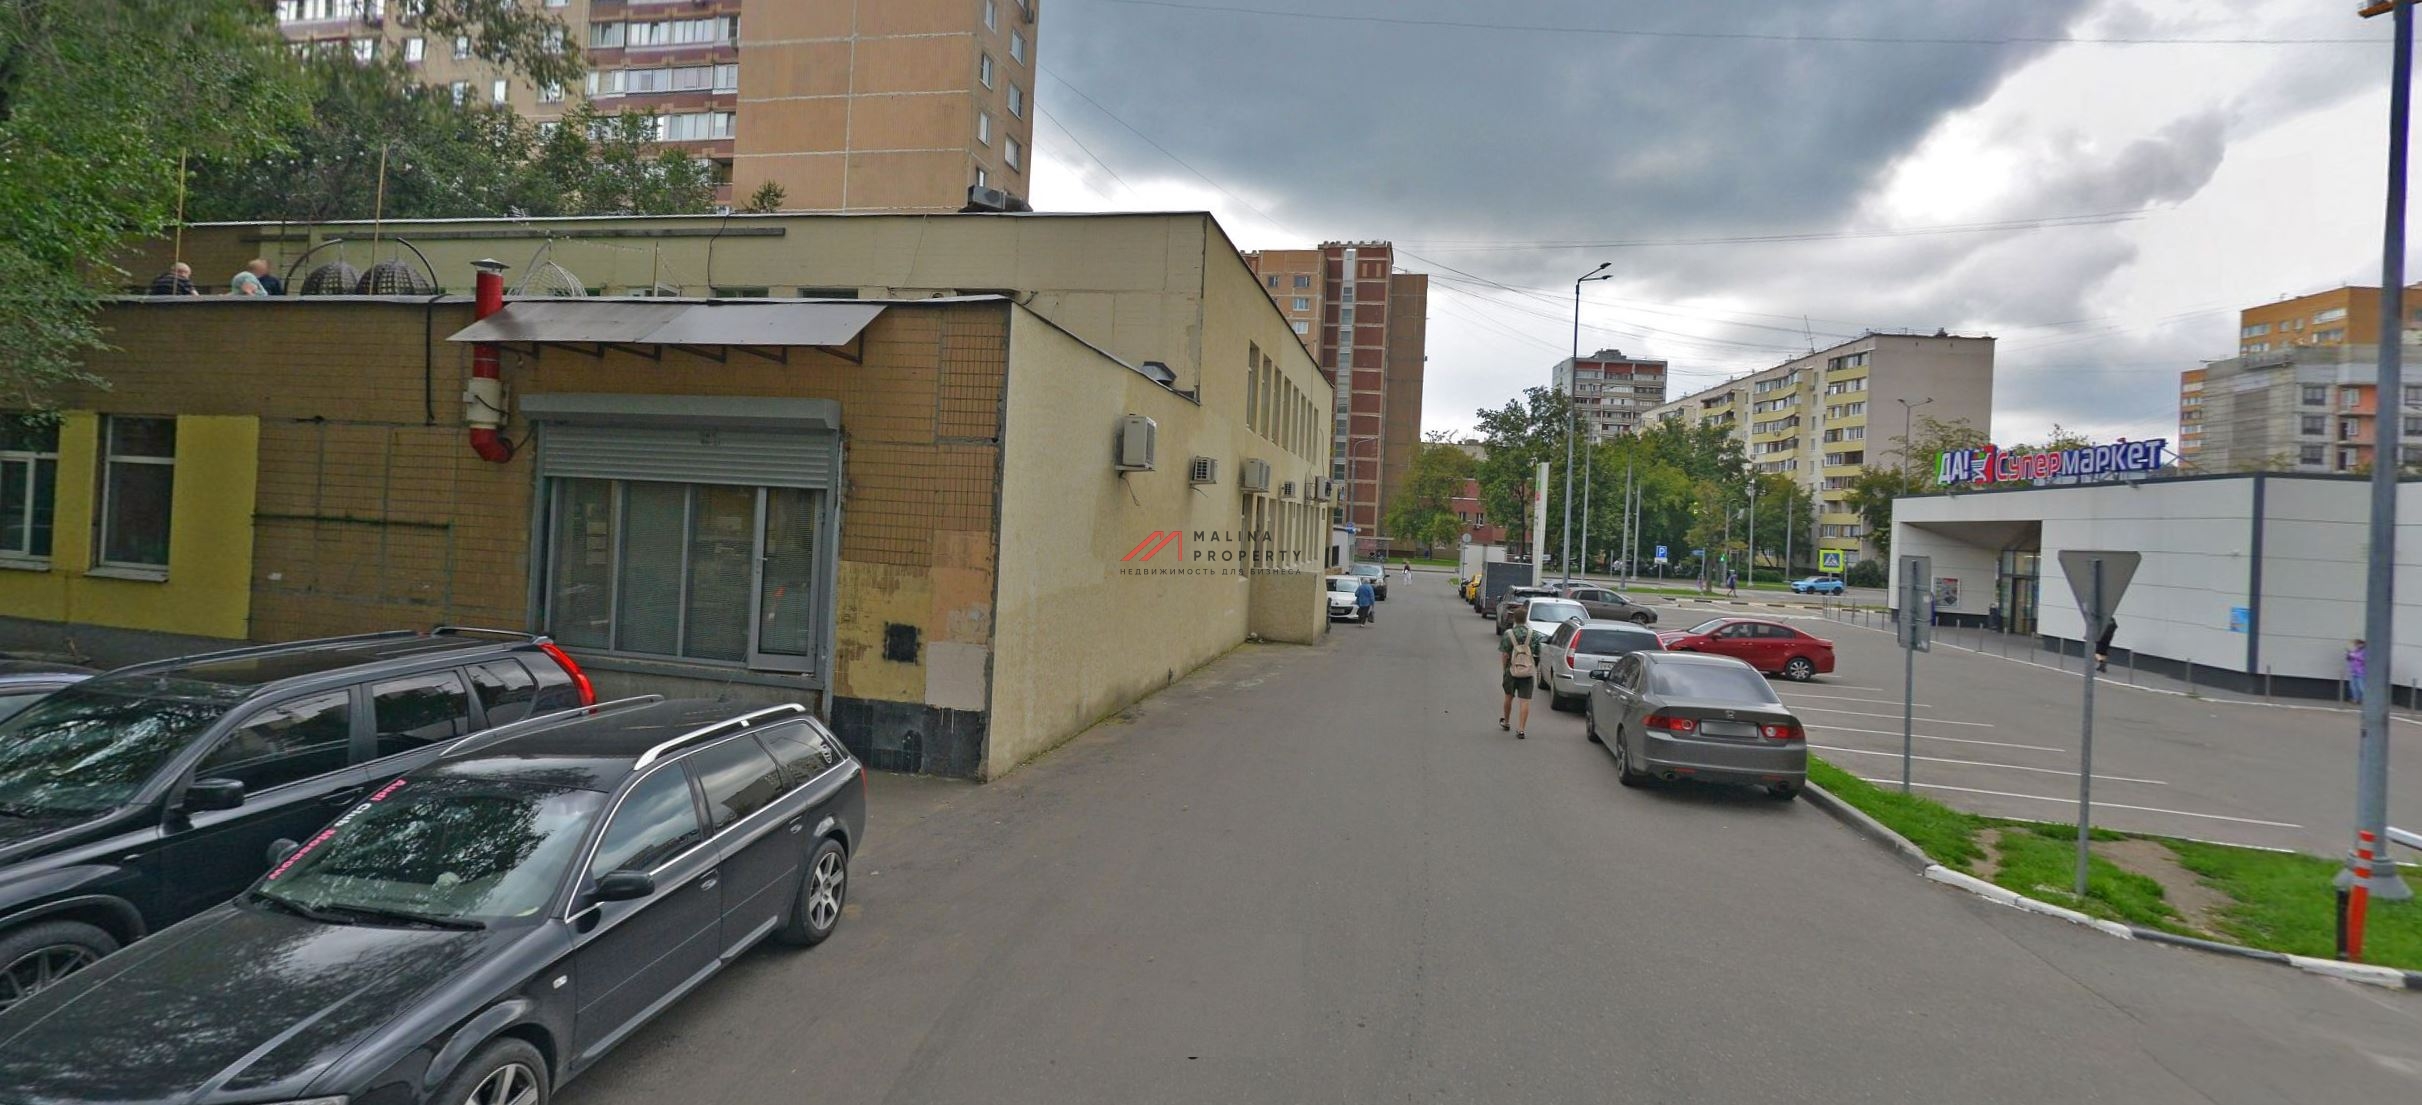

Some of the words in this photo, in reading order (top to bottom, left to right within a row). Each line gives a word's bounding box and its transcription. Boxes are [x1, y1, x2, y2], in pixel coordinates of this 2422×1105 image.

[1937, 450, 1970, 485] ДА!
[1995, 439, 2164, 482] Супермаркет
[370, 779, 407, 802] Audi
[334, 803, 372, 827] Club
